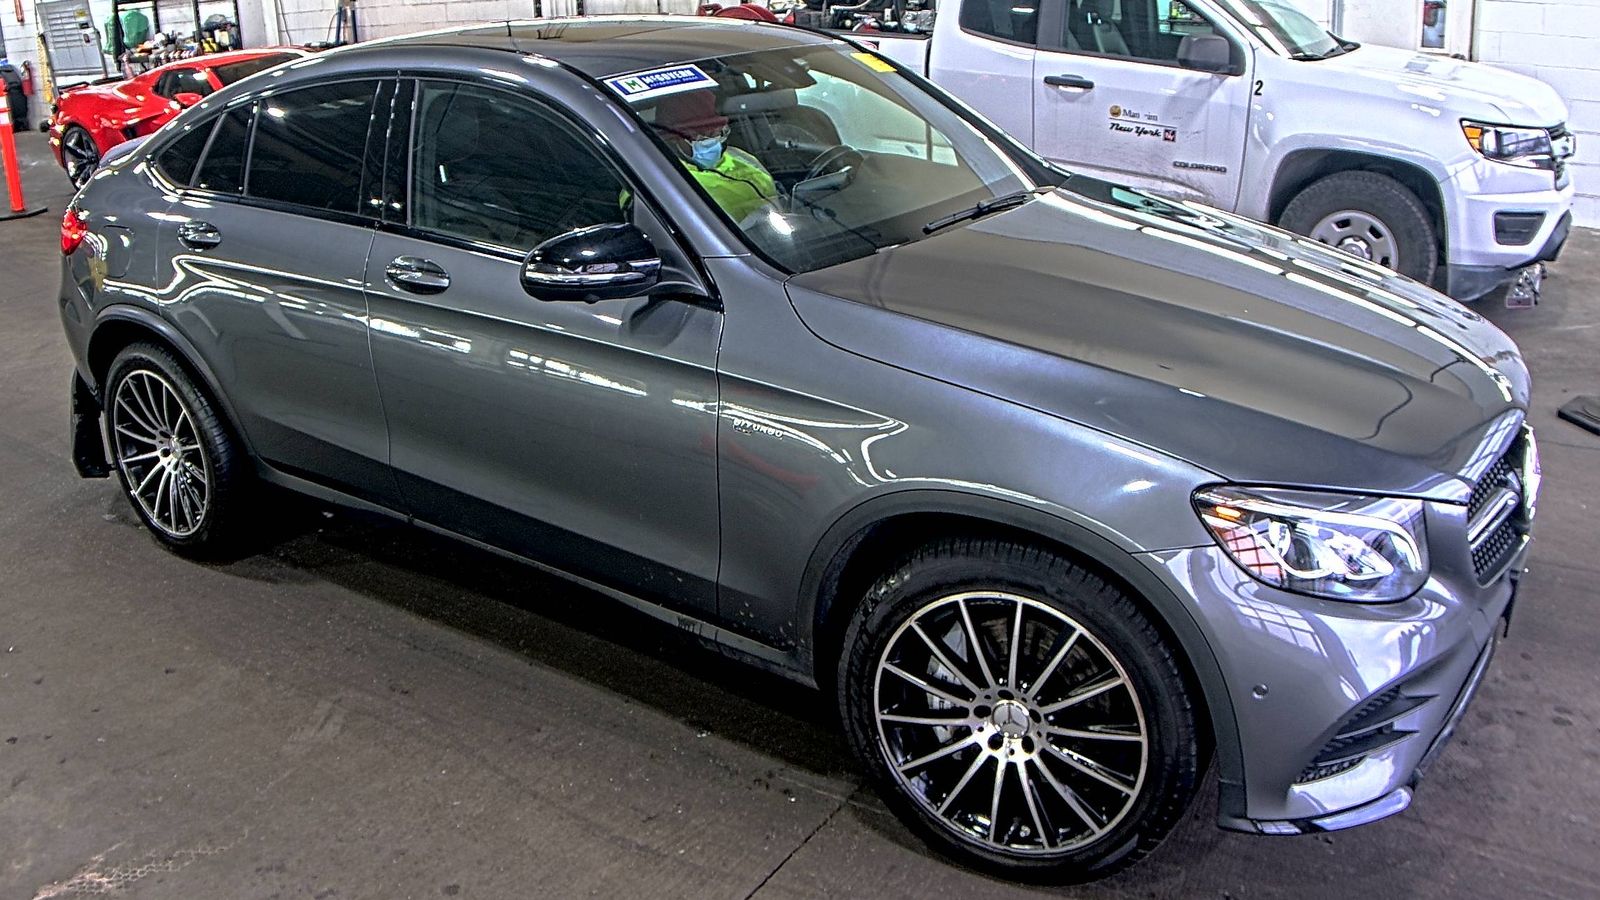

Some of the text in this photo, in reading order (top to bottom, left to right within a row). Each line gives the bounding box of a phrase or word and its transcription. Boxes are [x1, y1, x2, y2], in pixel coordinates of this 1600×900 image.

[1254, 80, 1264, 96] 2
[1109, 122, 1134, 133] New
[1135, 126, 1162, 137] York
[1172, 160, 1228, 173] COLORADO
